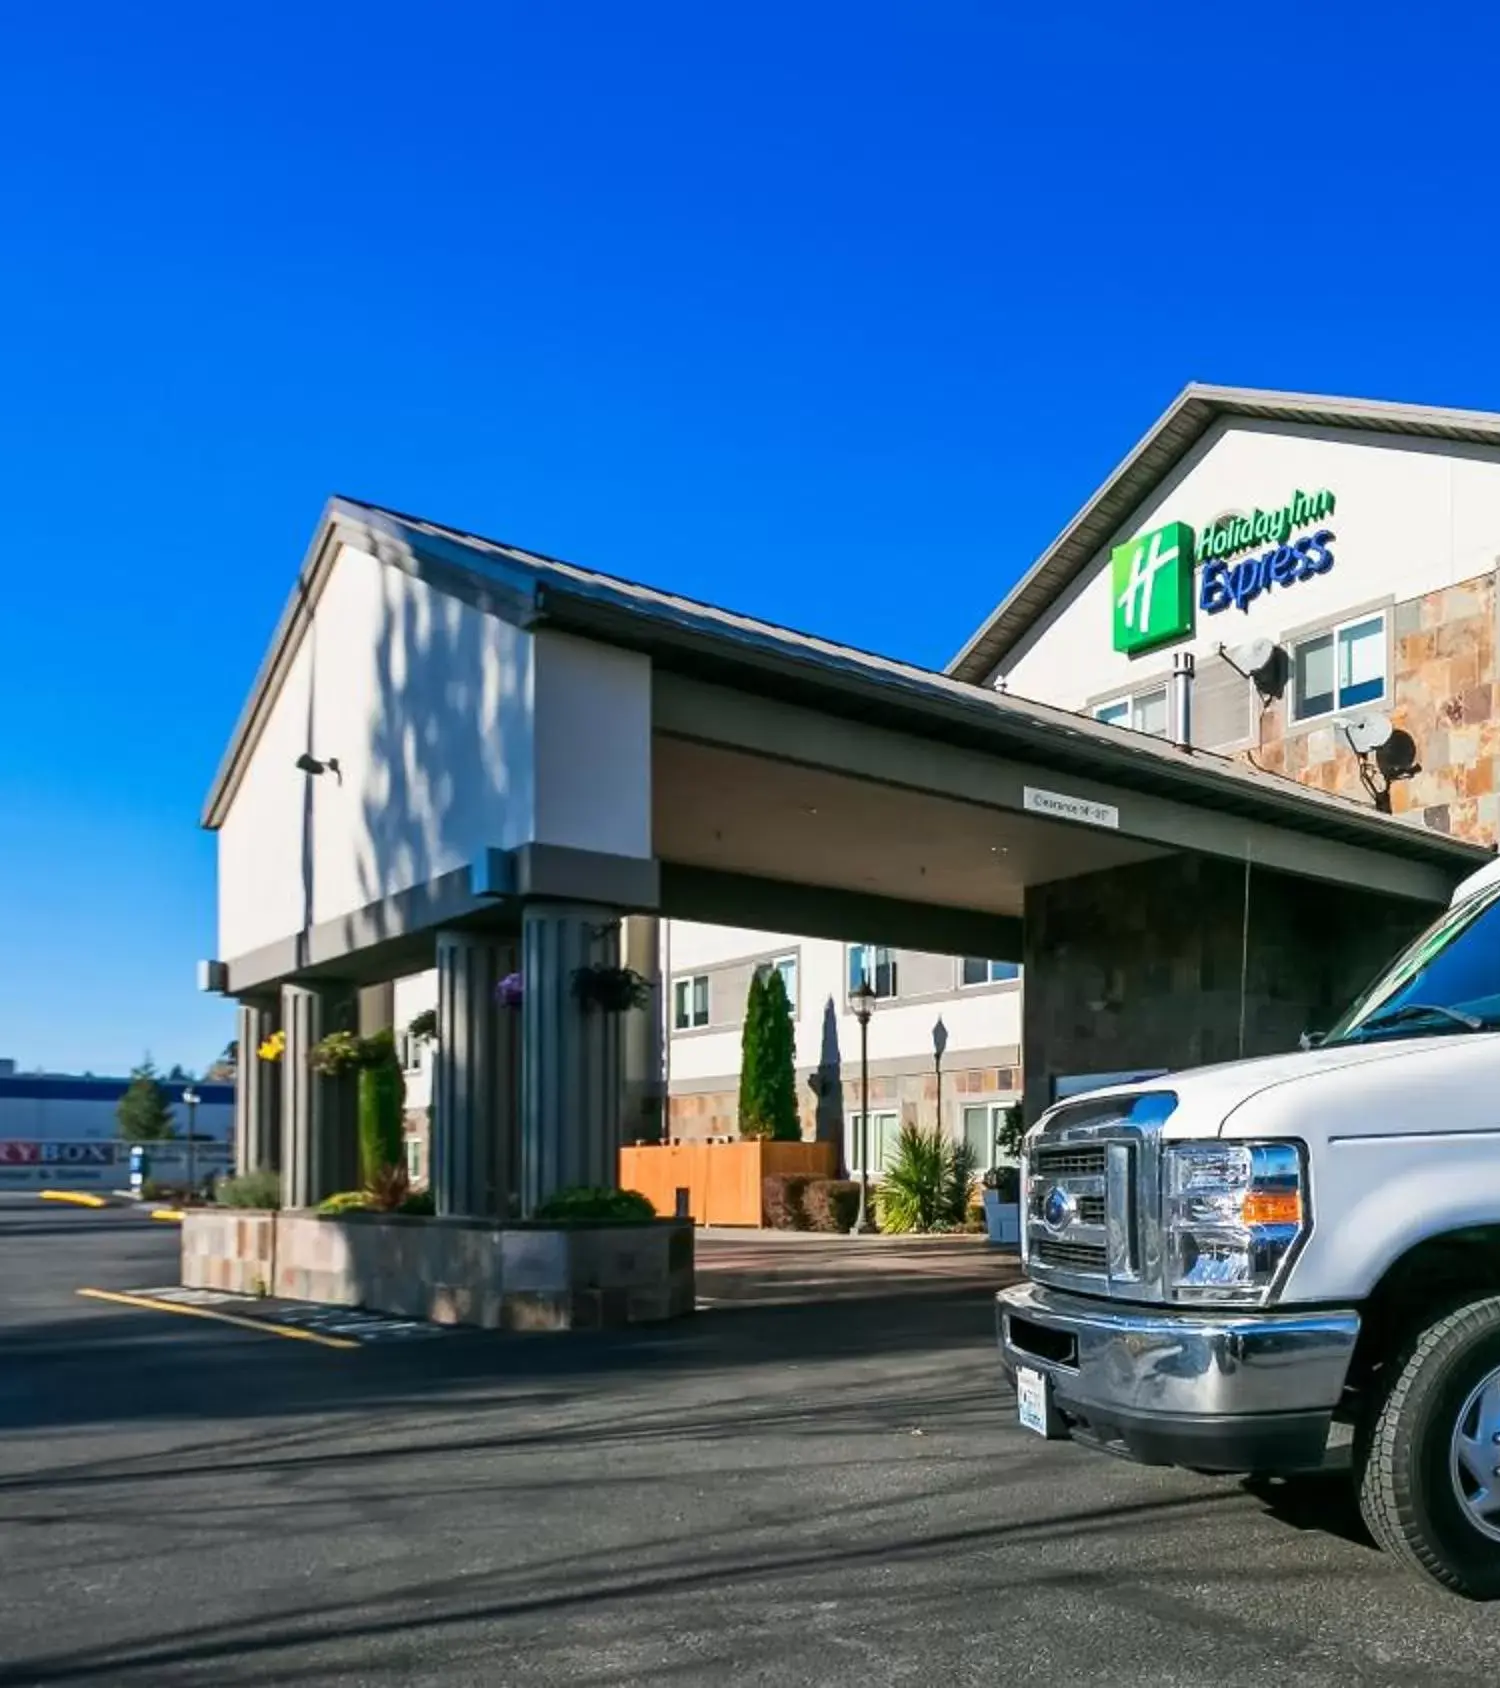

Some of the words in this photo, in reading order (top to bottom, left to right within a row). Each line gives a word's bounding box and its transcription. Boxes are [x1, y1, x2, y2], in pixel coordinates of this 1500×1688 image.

[1196, 507, 1289, 561] Holiday
[1288, 488, 1335, 528] Inn
[1199, 530, 1336, 616] Express
[1033, 794, 1078, 815] Cearance
